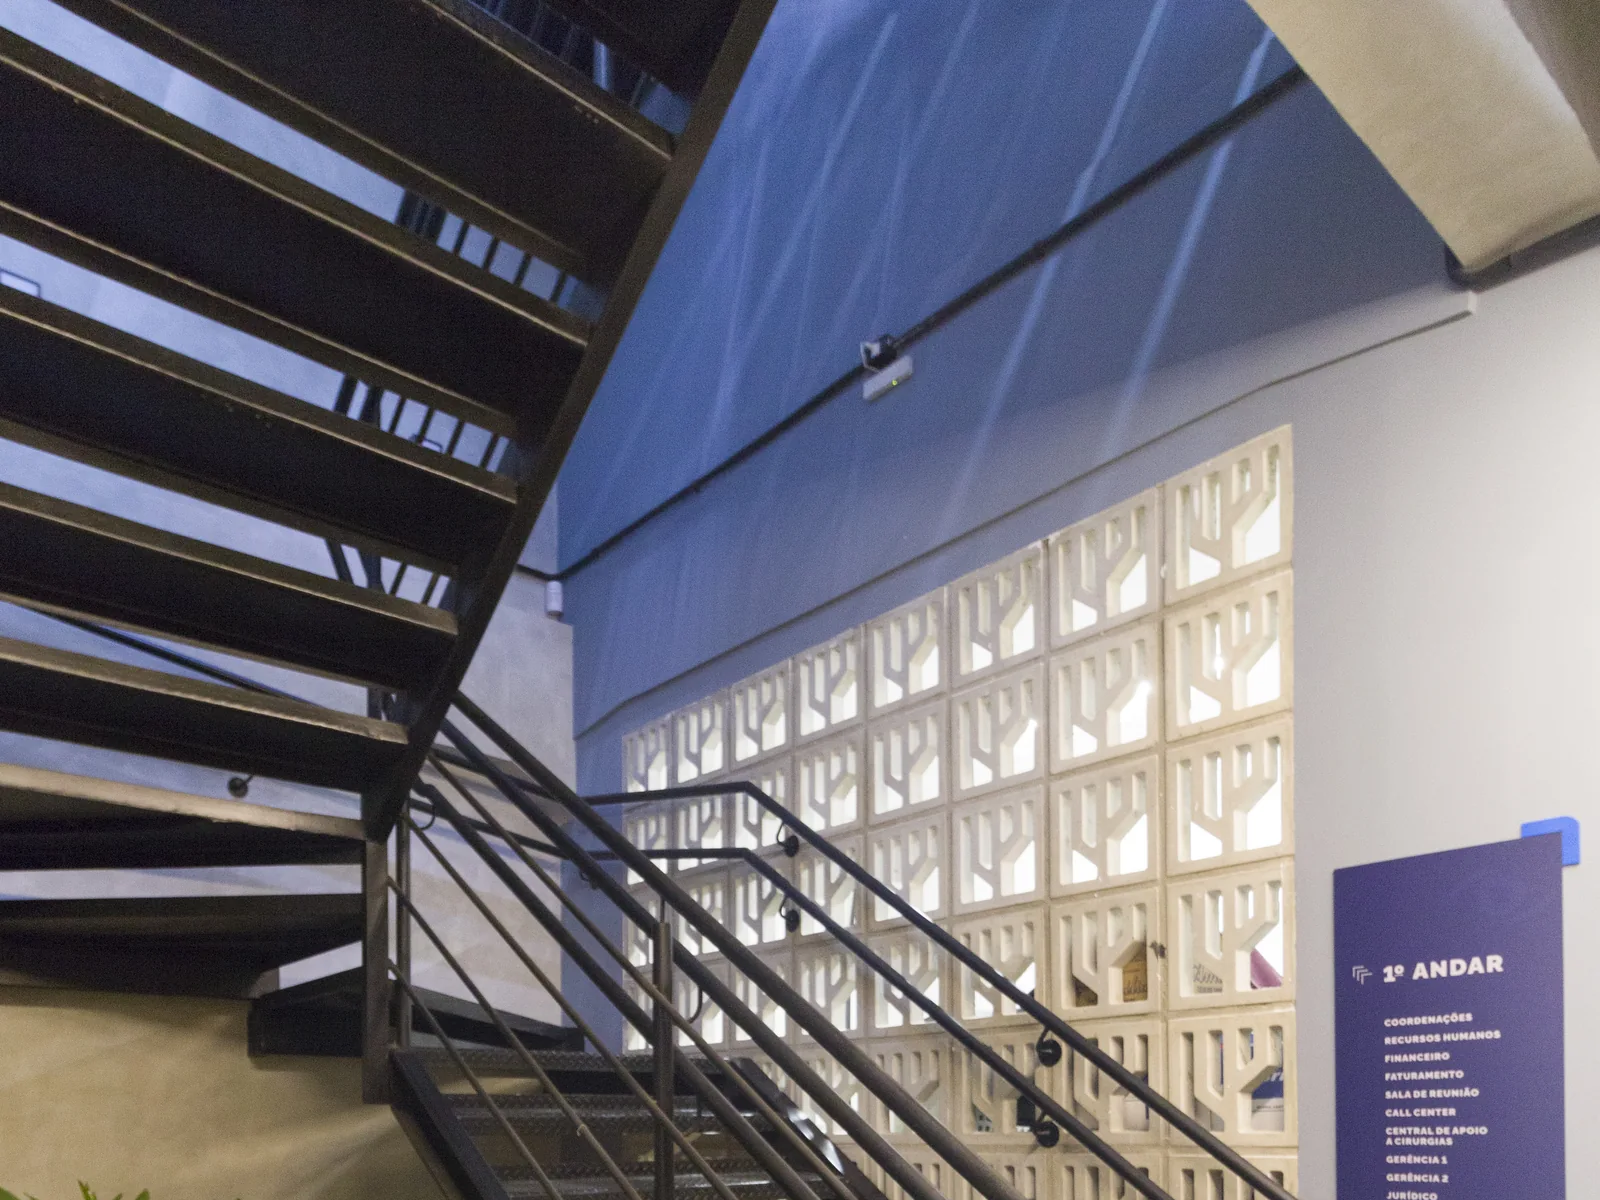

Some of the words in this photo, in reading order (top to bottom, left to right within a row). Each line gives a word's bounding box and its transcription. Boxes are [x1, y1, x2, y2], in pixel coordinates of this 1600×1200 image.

[1412, 954, 1503, 980] ANDAR
[1384, 1012, 1473, 1027] COORDENAÇÕES
[1384, 1034, 1441, 1045] RECURSOS
[1443, 1030, 1501, 1042] HUMANOS
[1384, 1052, 1450, 1063] FINANCEIRO
[1385, 1070, 1464, 1081] FATURAMENTO
[1385, 1090, 1412, 1100] SALA
[1413, 1089, 1427, 1098] DE
[1429, 1087, 1480, 1098] REUNIÃO
[1385, 1109, 1412, 1117] CALL
[1413, 1108, 1456, 1117] CENTER
[1385, 1127, 1434, 1136] CENTRAL
[1436, 1127, 1450, 1135] DE
[1452, 1126, 1488, 1135] APOIO
[1394, 1137, 1453, 1146] CIRURGIAS
[1386, 1154, 1439, 1164] GERÊNCIA
[1441, 1156, 1448, 1164] 1
[1386, 1173, 1439, 1182] GERÊNCIA
[1441, 1175, 1449, 1183] 2
[1386, 1191, 1438, 1200] JURÍDICO
